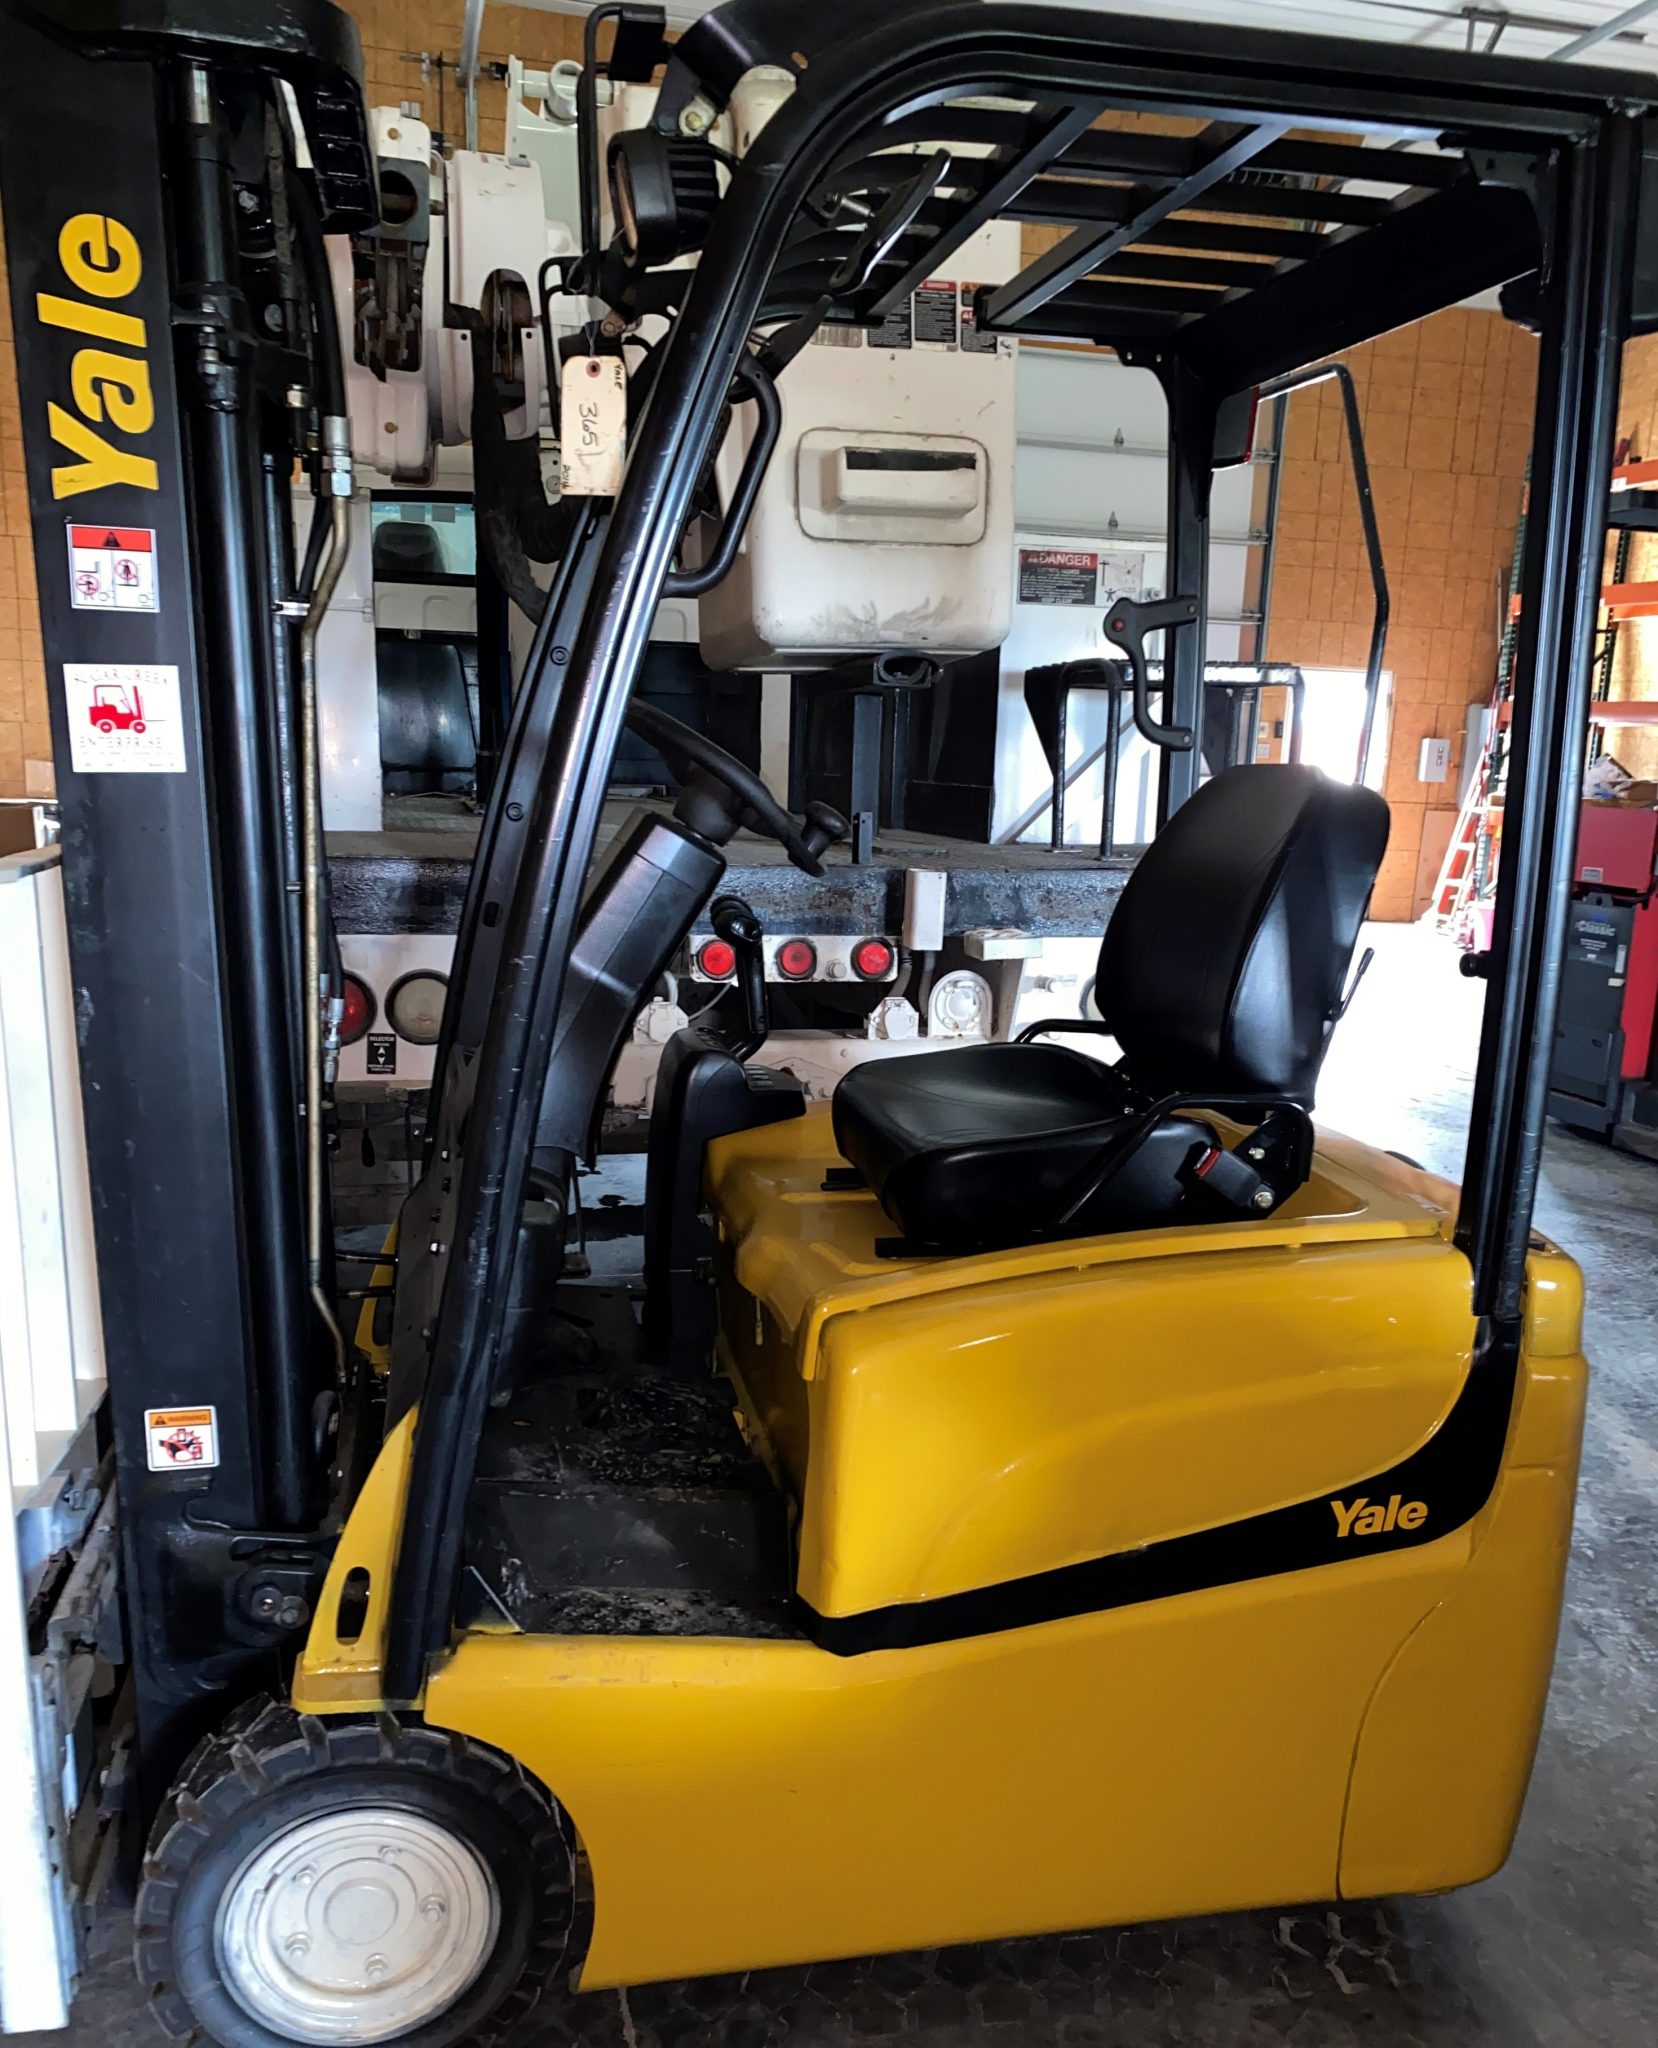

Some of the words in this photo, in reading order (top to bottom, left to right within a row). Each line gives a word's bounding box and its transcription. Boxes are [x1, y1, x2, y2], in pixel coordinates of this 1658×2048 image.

[36, 213, 159, 500] Yale
[1039, 552, 1092, 567] DANGER
[1330, 1494, 1429, 1538] Yale
